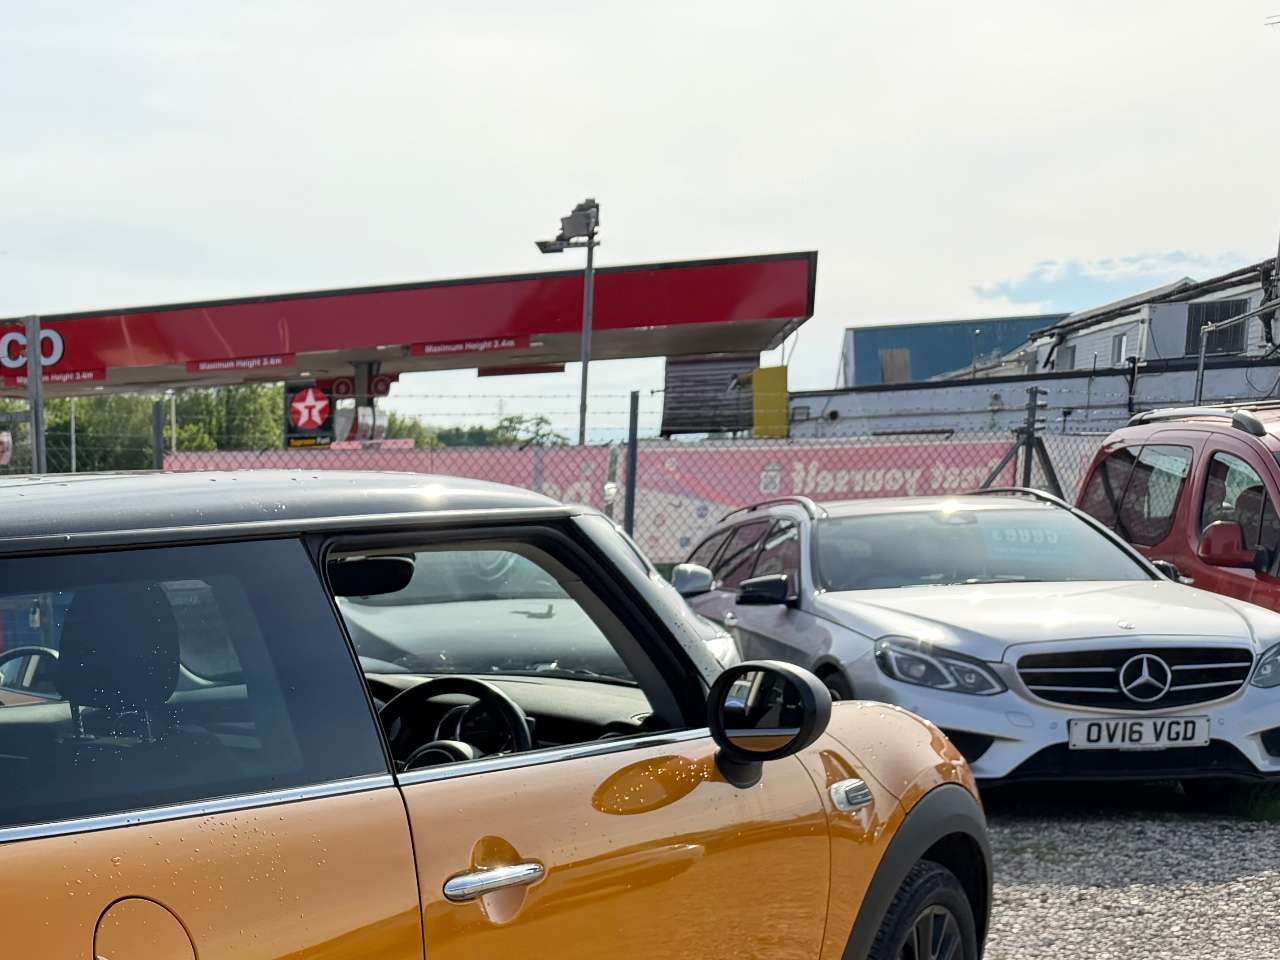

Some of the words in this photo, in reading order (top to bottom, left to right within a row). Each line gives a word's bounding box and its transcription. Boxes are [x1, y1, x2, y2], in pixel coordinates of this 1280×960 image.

[425, 343, 464, 353] Maximum
[465, 341, 492, 351] Height
[199, 359, 235, 370] Maximum
[236, 357, 261, 368] Height
[1086, 722, 1144, 744] OV16
[1153, 720, 1196, 742] VGD
